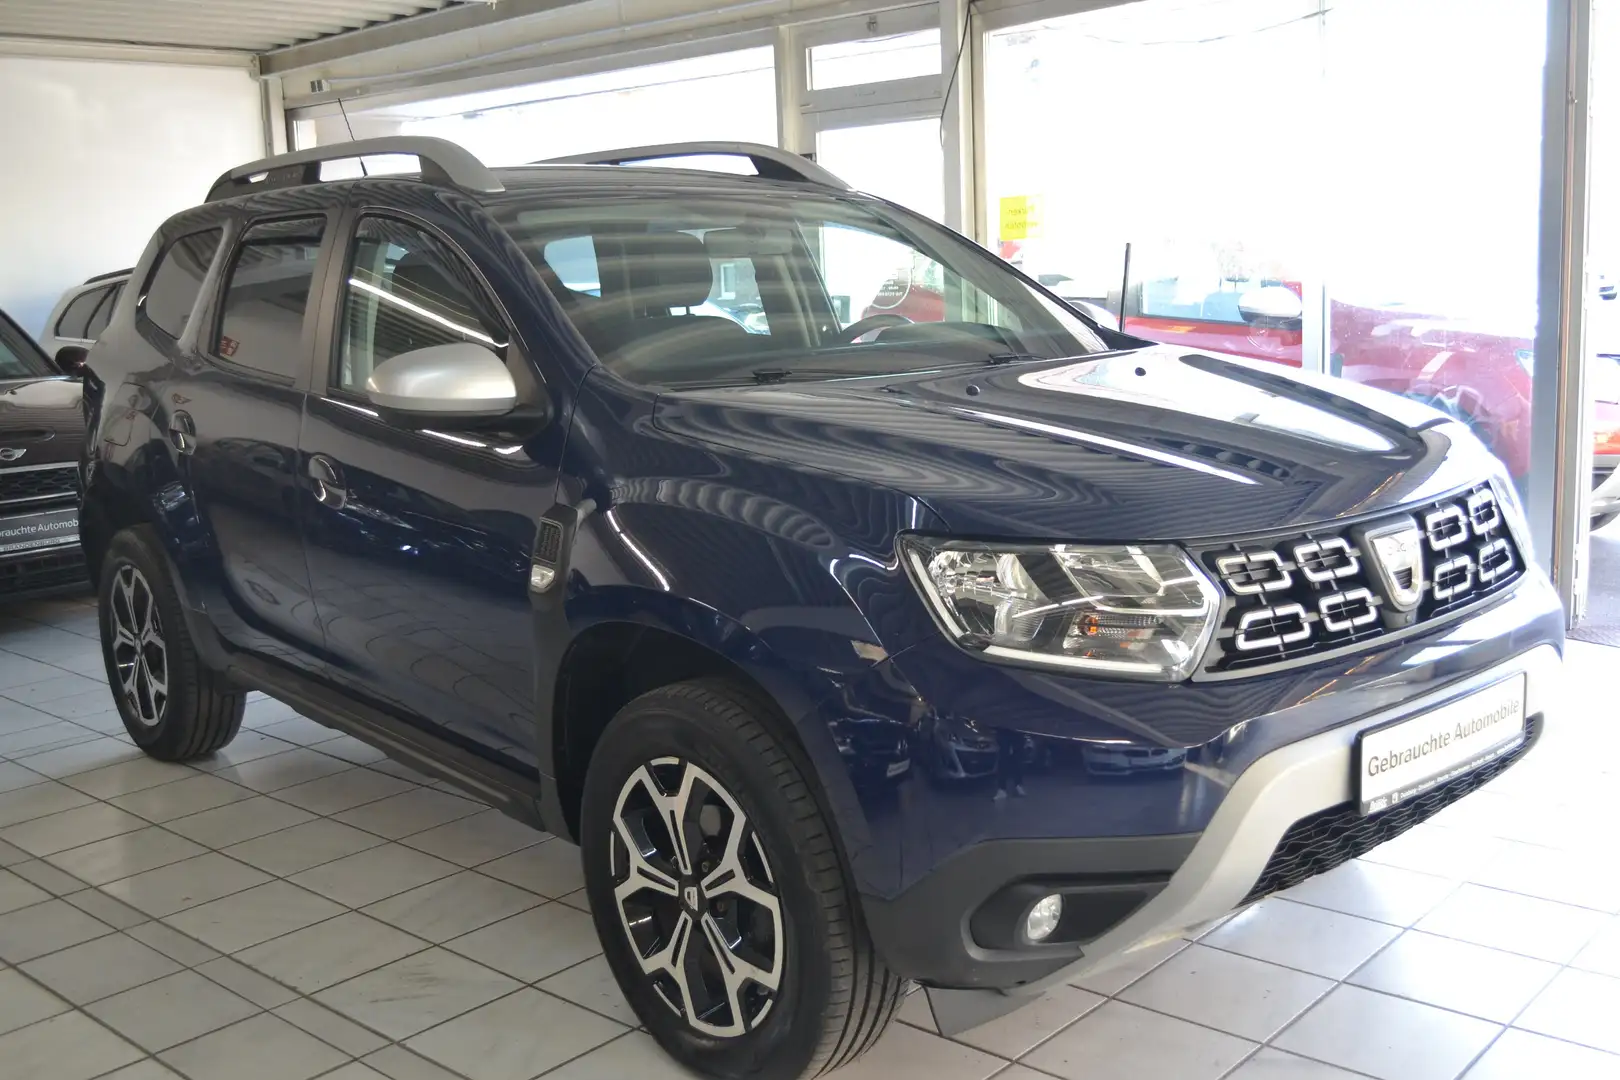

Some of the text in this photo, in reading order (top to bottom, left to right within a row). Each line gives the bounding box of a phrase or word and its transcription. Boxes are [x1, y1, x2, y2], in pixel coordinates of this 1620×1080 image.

[38, 519, 79, 531] Automob
[1368, 732, 1450, 777] Gebrauchte
[1454, 699, 1519, 741] Automobile
